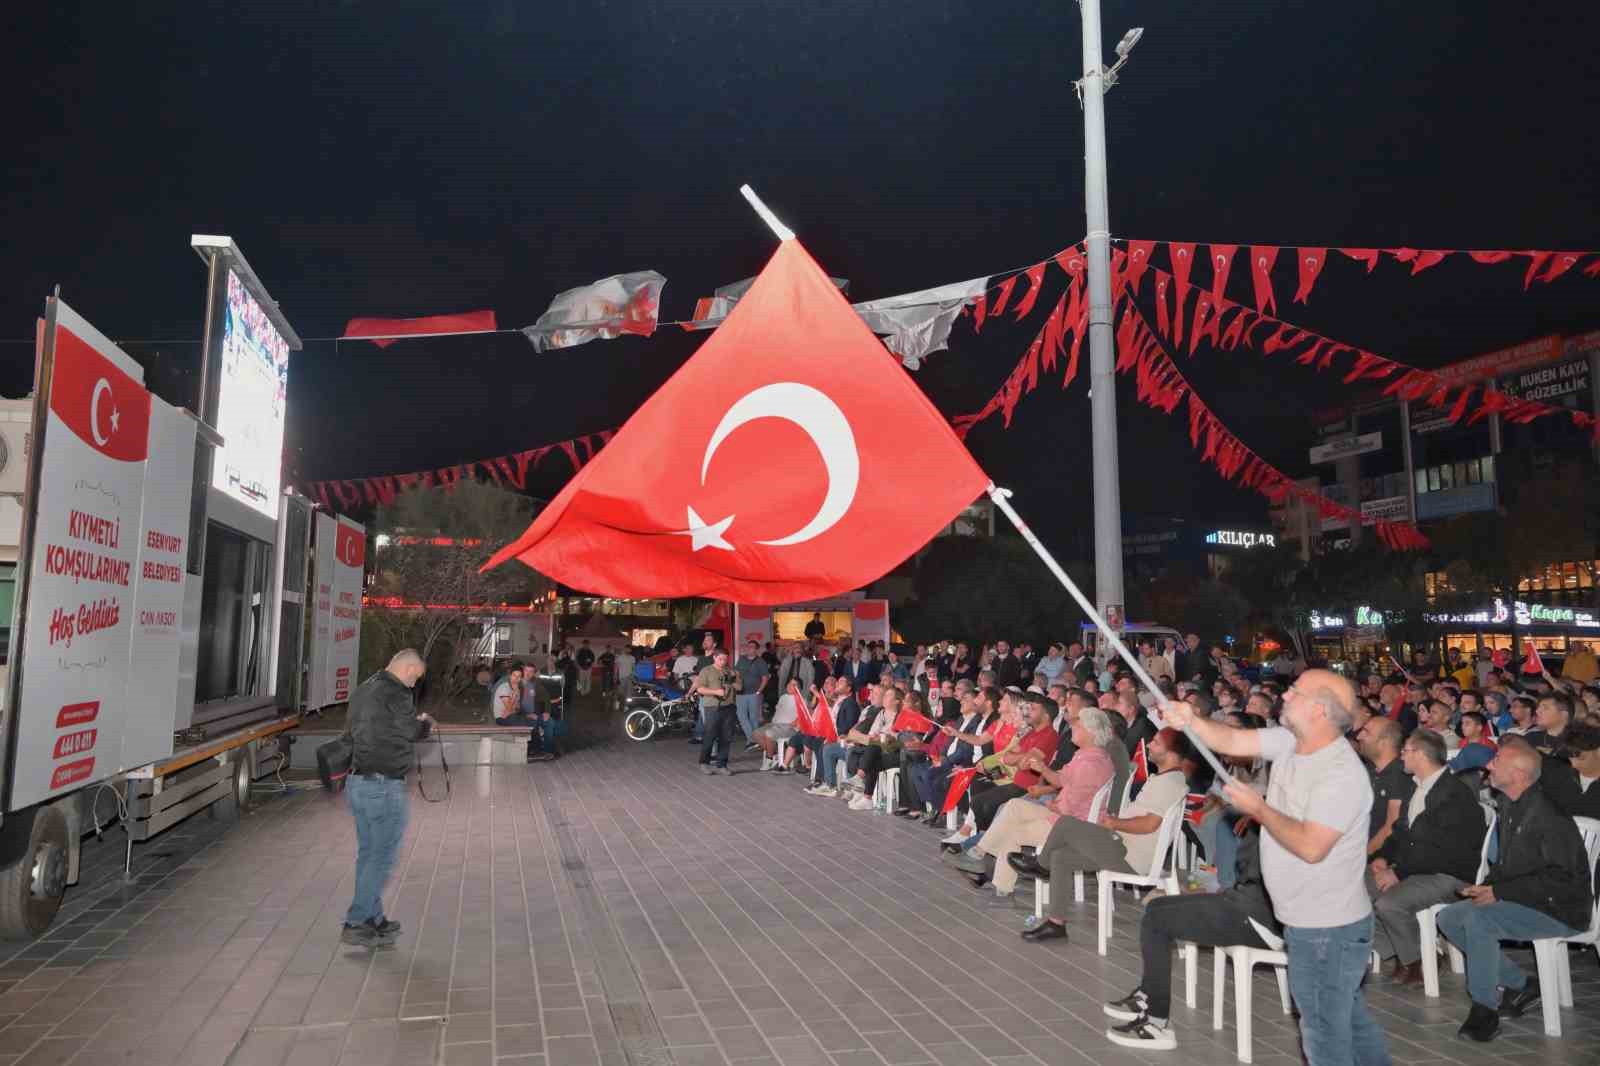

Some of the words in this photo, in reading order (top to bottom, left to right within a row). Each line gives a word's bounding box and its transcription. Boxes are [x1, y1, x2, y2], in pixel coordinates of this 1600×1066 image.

[1559, 360, 1588, 379] KAYA
[1526, 377, 1587, 401] GÜZELLİK
[69, 510, 119, 549] KIYMETLİ
[147, 531, 181, 553] ESENYURT
[46, 544, 129, 587] KOMŞULARIMIZ
[143, 561, 180, 584] BELEDİYESİ
[49, 607, 74, 648] Hoş
[77, 596, 119, 635] Geldiniz
